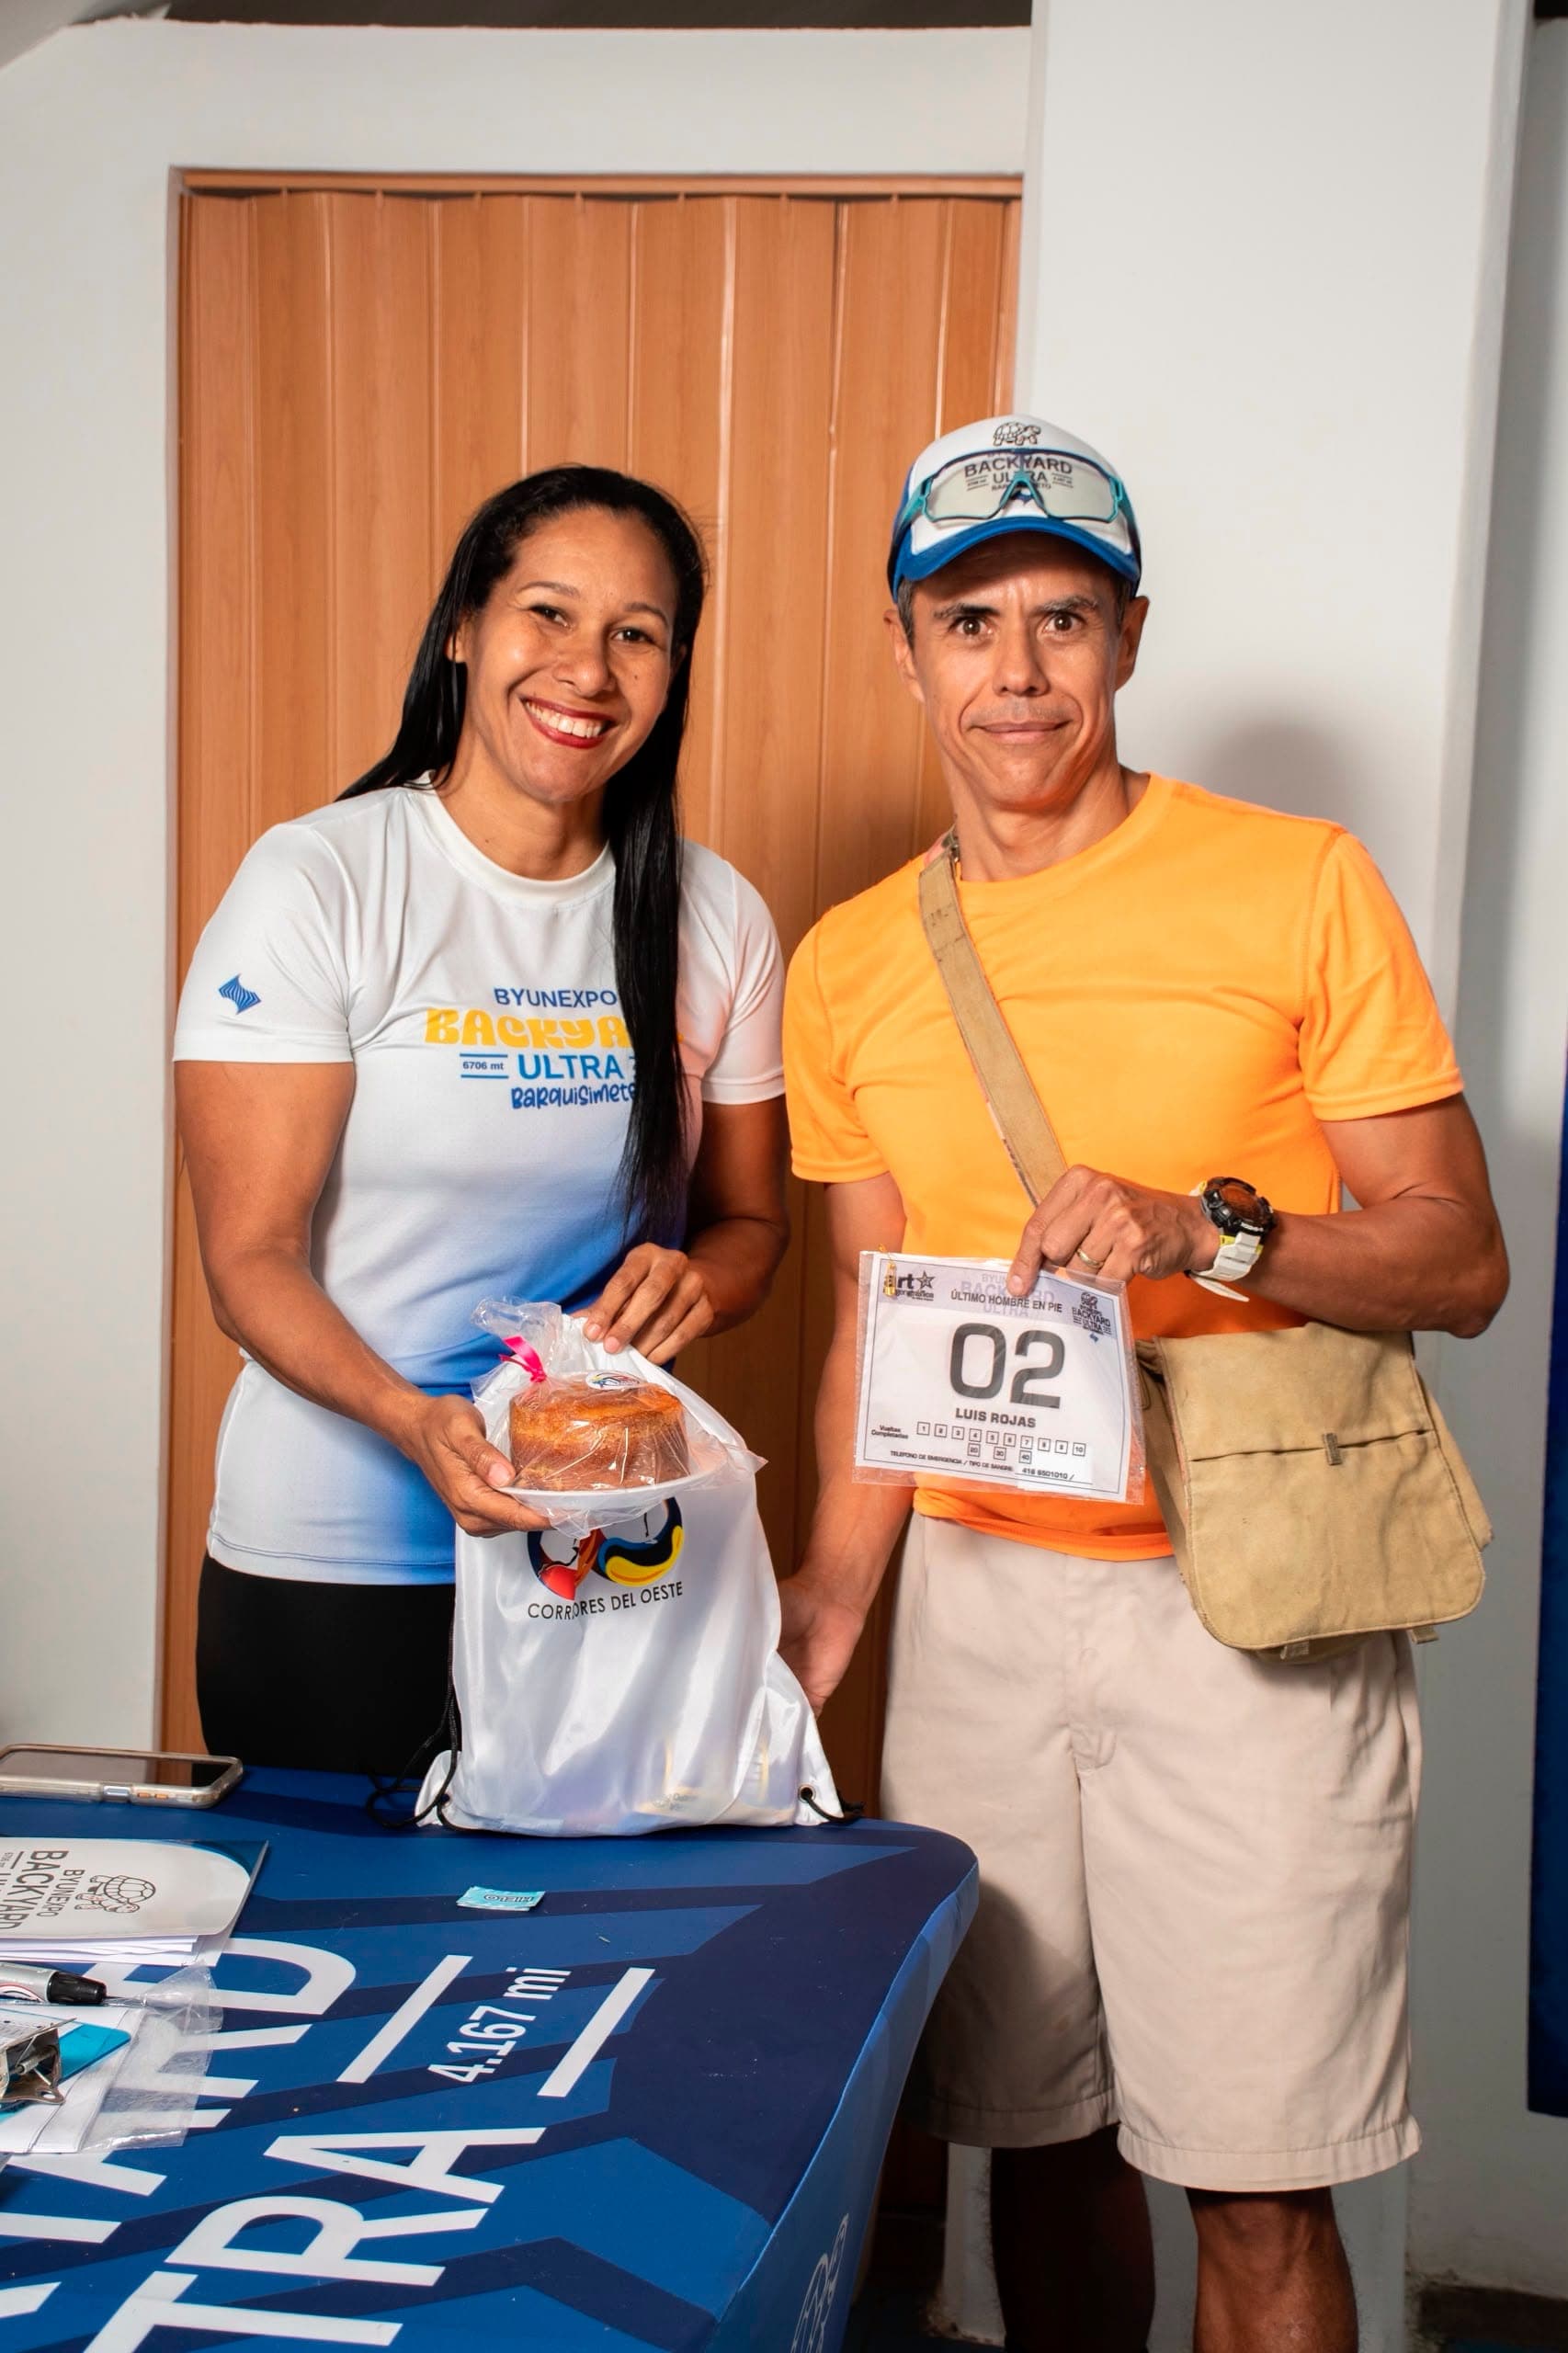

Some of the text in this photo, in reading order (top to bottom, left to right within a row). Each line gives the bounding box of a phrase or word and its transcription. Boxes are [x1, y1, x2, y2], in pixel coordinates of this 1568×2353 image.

[993, 471, 1048, 483] ULRA
[494, 988, 618, 1008] BYUNEXPO
[425, 1007, 634, 1050] BACKYA
[462, 1061, 505, 1071] 6706 mt
[517, 1053, 625, 1080] ULTRA
[950, 1289, 1063, 1313] ÚLTIMO HOMBRE EN PIE
[949, 1322, 1065, 1409] 02
[955, 1407, 1037, 1428] LUIS ROJAS
[610, 1592, 637, 1610] DEL
[641, 1581, 683, 1604] OESTE
[36, 1870, 85, 1917] BYUNEXPO
[427, 1966, 573, 2083] 4.167 mi
